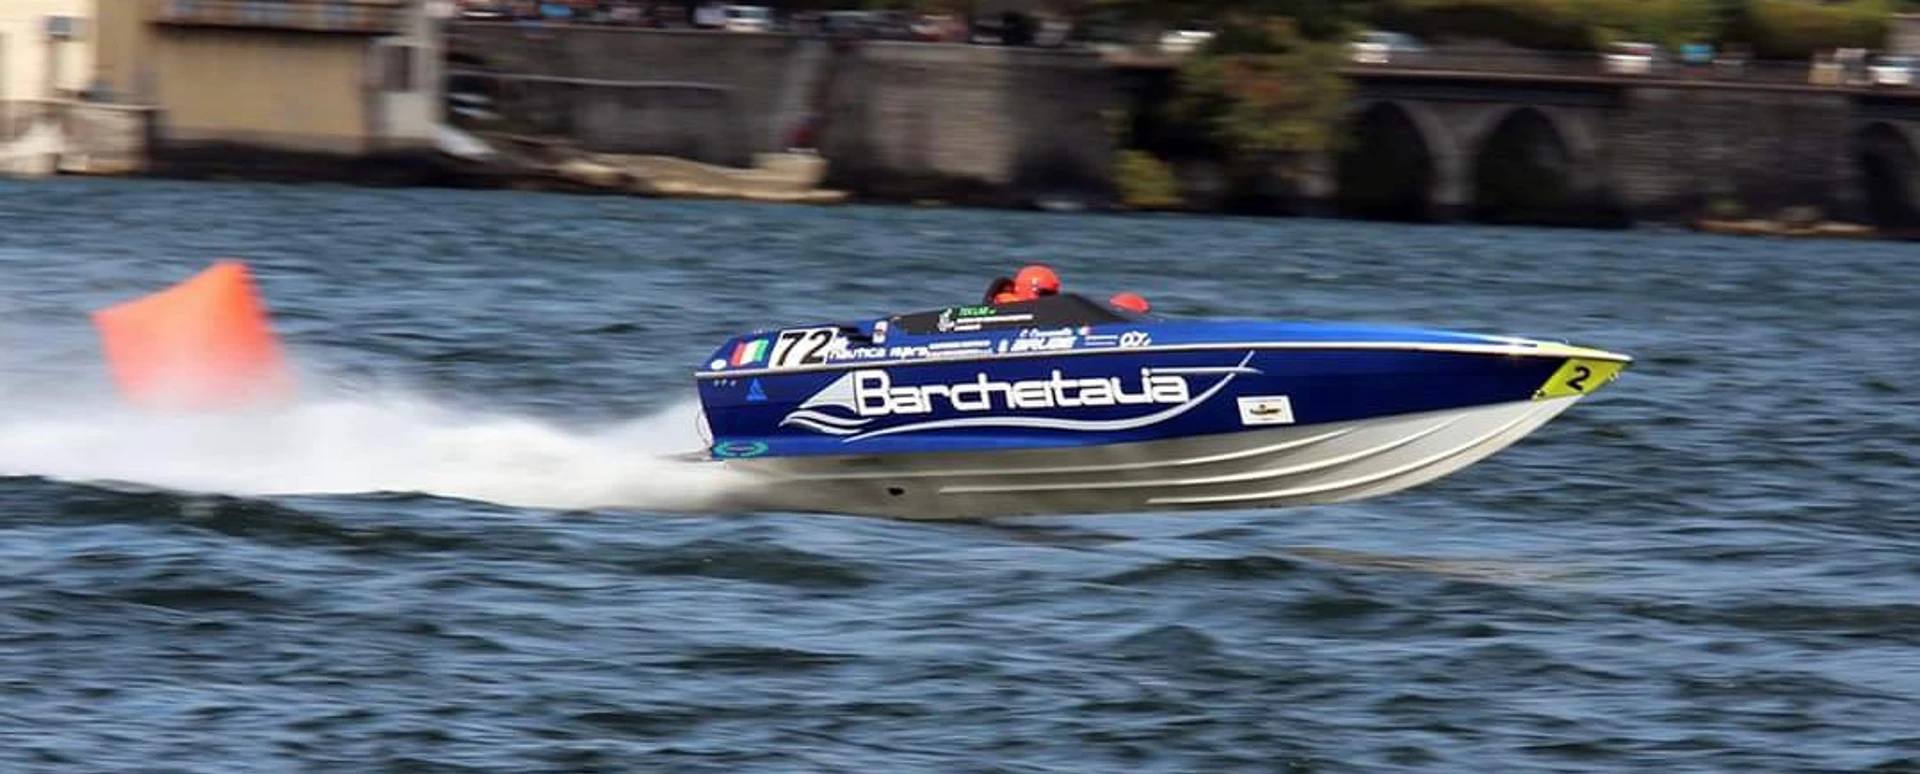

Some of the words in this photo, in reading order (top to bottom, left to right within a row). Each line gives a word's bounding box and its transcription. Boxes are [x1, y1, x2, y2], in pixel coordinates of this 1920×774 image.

[776, 330, 834, 367] 72
[853, 368, 1190, 417] Barcheitalia
[1565, 364, 1591, 392] 2
